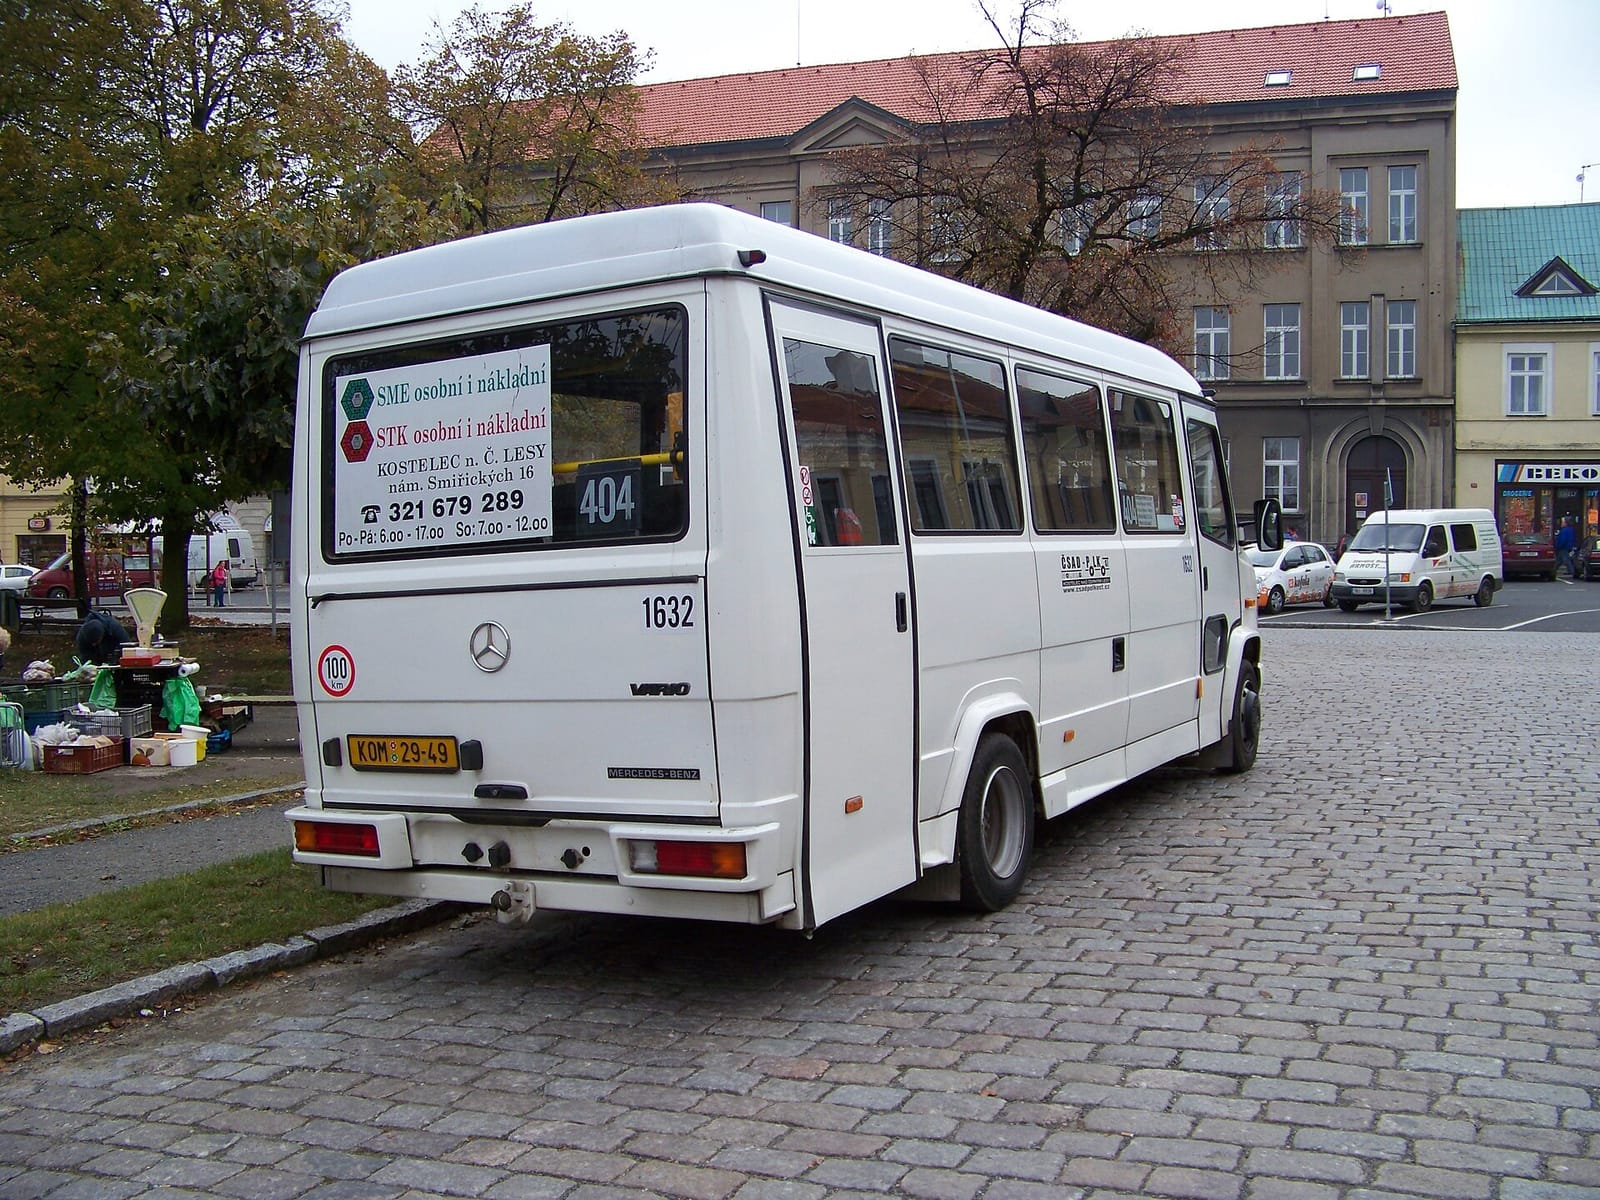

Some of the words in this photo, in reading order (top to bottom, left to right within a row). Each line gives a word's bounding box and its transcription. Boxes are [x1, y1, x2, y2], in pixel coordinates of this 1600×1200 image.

[377, 383, 410, 407] SME
[414, 375, 463, 402] osobní
[467, 374, 472, 395] i
[477, 362, 547, 394] nákladní
[376, 425, 409, 448] STK
[413, 418, 462, 444] osobní
[467, 417, 472, 438] i
[476, 407, 547, 437] nákladní
[377, 454, 461, 477] KOSTELEC
[465, 456, 479, 467] n.
[483, 446, 498, 465] Č.
[503, 443, 547, 463] LESY
[388, 479, 424, 494] nám.
[427, 467, 514, 490] Smiřických
[519, 464, 535, 480] 16
[389, 499, 424, 522] 321
[432, 495, 472, 518] 679
[481, 489, 524, 513] 289
[580, 475, 635, 524] 404
[379, 529, 404, 543] 6.00
[415, 525, 444, 541] 17.00
[478, 520, 503, 536] 7.00
[515, 515, 548, 532] 12.00
[642, 595, 694, 629] 1632
[325, 657, 347, 679] 100
[331, 680, 344, 689] km
[629, 682, 691, 696] VARIO
[357, 740, 388, 763] KOM
[400, 741, 448, 764] 29-49
[608, 768, 699, 780] MERCEDES-BENZ
